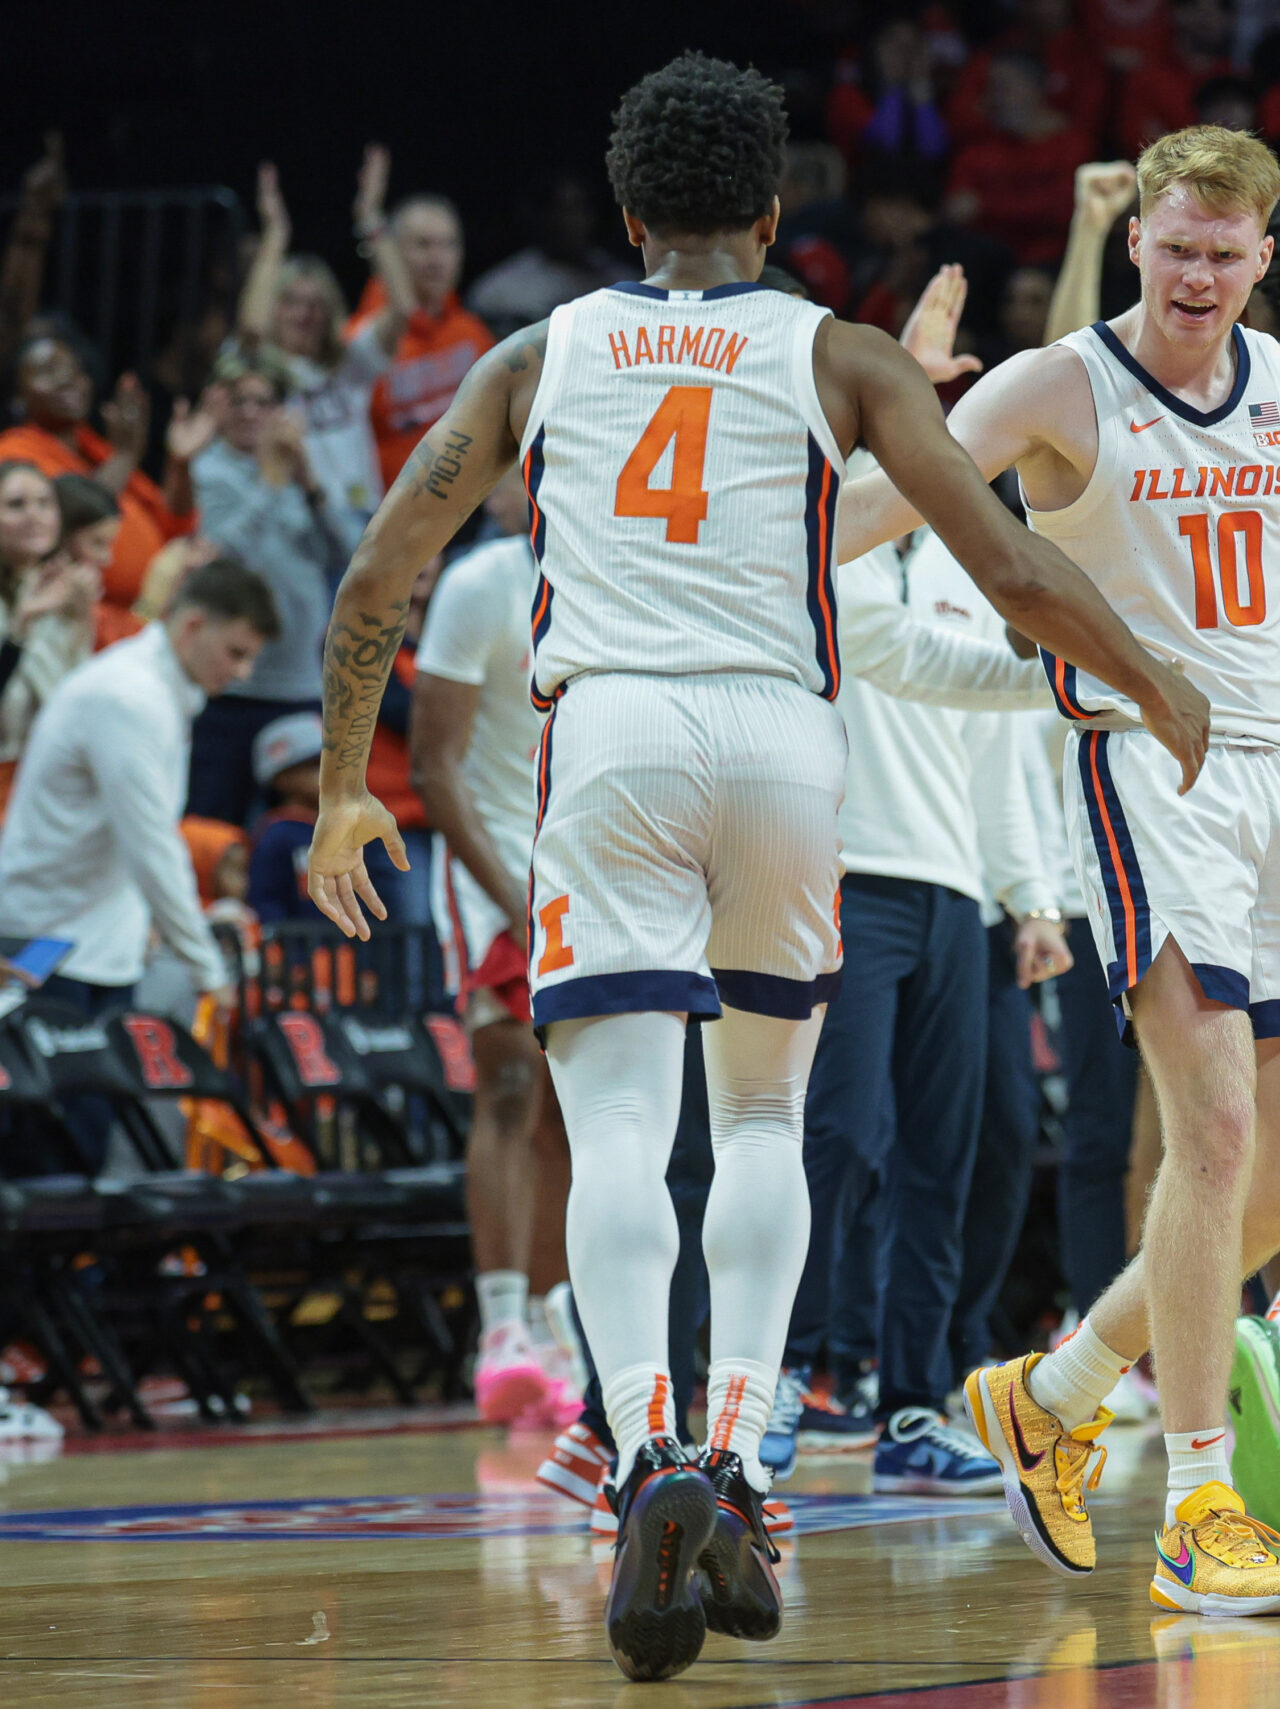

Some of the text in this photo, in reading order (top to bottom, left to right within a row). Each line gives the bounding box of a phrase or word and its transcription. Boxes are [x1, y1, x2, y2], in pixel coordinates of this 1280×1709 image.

[608, 325, 749, 375] HARMON
[613, 385, 713, 544] 4
[1178, 510, 1266, 629] 10
[538, 894, 574, 978] I
[125, 1013, 193, 1088] R
[279, 1013, 340, 1086] R
